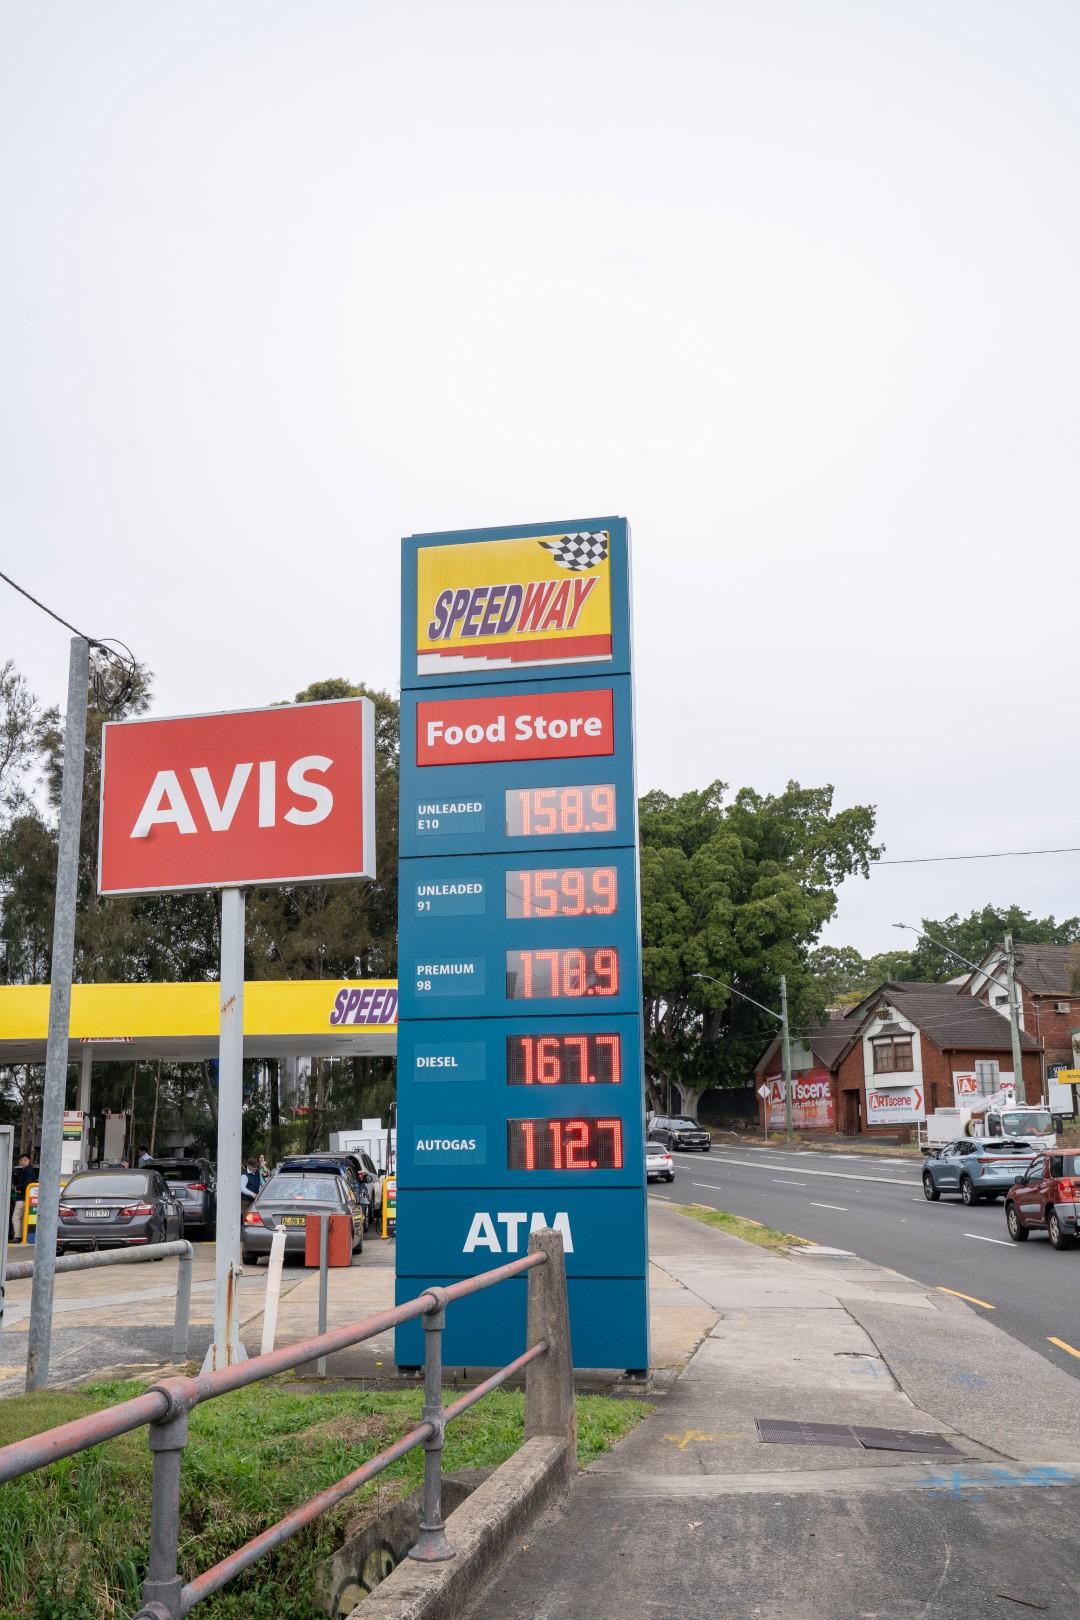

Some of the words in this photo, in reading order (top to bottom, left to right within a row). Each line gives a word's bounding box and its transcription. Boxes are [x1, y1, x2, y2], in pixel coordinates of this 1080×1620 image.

[428, 576, 600, 641] SPEEDWAY
[427, 716, 506, 746] Food
[515, 714, 603, 741] Store
[129, 755, 334, 839] AVIS
[418, 802, 483, 815] UNLEADED
[519, 786, 614, 835] 158.9
[418, 819, 439, 830] E10
[417, 884, 483, 896] UNLEADED
[417, 901, 431, 911] 91
[519, 869, 617, 917] 159.9
[416, 980, 432, 991] 98
[417, 963, 474, 976] PREMIUM
[519, 949, 618, 997] 178.9
[329, 987, 398, 1025] SPEED
[416, 1057, 458, 1068] DIESEL
[521, 1036, 621, 1085] 167.7
[416, 1139, 476, 1151] AUTOGAS
[521, 1120, 622, 1170] 112.7
